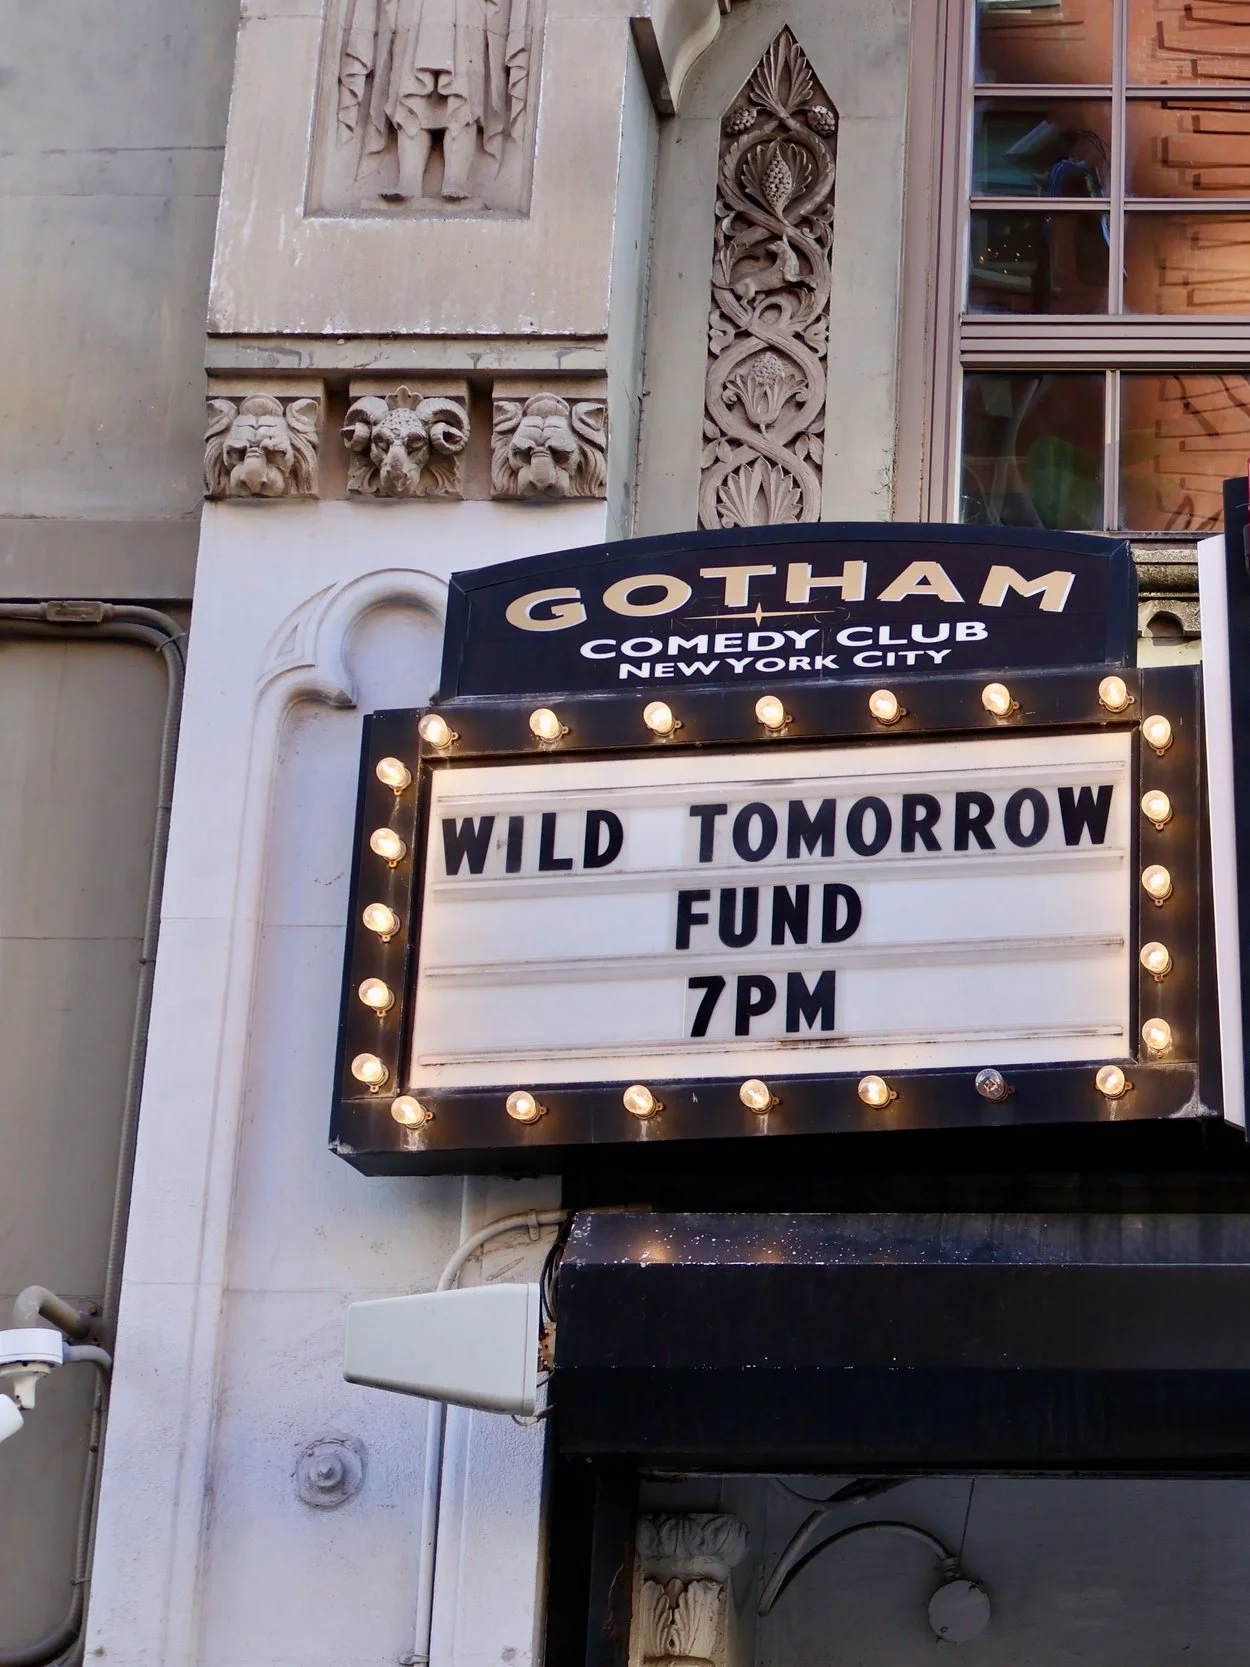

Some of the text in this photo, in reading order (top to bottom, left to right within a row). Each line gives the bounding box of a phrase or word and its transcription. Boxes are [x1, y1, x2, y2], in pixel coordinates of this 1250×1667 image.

[505, 560, 1076, 632] GOTHAM
[580, 621, 989, 659] COMEDY CLUB
[619, 649, 952, 679] NEW YORK CITY
[441, 785, 1114, 876] WILD TOMORROW
[676, 883, 862, 950] FUND
[688, 970, 836, 1038] 7PM
